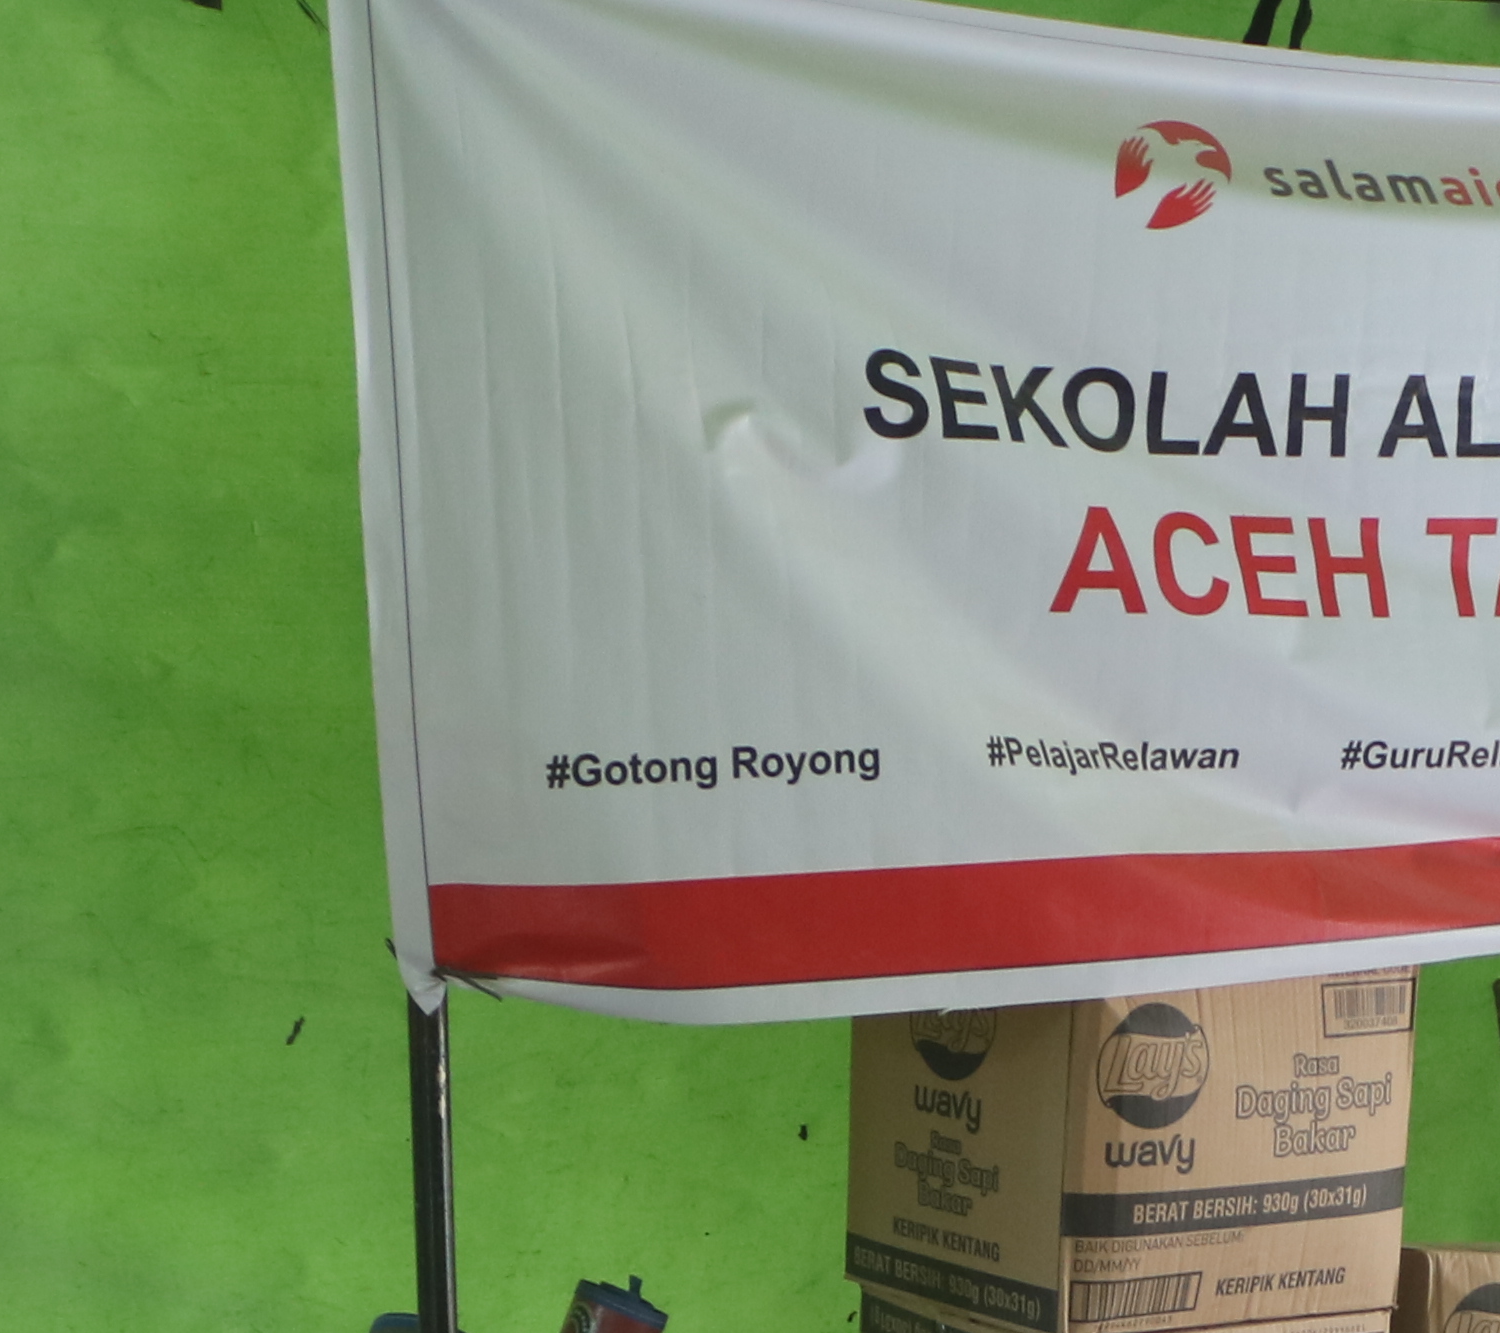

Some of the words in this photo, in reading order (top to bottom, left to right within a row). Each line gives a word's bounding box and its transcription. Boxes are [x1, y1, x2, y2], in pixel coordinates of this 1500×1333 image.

[862, 348, 1349, 458] SEKOLAH
[1048, 505, 1390, 618] ACEH
[545, 749, 718, 791] #Gotong
[730, 742, 882, 784] Royong
[986, 735, 1241, 775] #PelajarRelawan
[1104, 1031, 1203, 1101] Lay's
[1294, 1054, 1340, 1077] Rasa
[915, 1085, 981, 1134] wavy
[1236, 1084, 1331, 1124] Daging
[1336, 1073, 1393, 1115] Sapi
[1105, 1134, 1195, 1174] wavy
[1274, 1119, 1357, 1157] Bakar
[894, 1141, 957, 1187] Daging
[958, 1158, 999, 1196] Sapi
[918, 1182, 972, 1216] Bakar
[1133, 1201, 1189, 1225] BERAT
[1193, 1197, 1257, 1220] BERSIH:
[1262, 1191, 1299, 1215] 930g
[1303, 1184, 1367, 1212] (30x31g)
[893, 1216, 938, 1246] KERIPIK
[943, 1230, 1000, 1262] KENTANG
[1075, 1239, 1109, 1254] BAIK
[1112, 1235, 1183, 1253] DIGUNAKAN
[1187, 1230, 1245, 1247] SEBELUM:
[854, 1246, 891, 1274] BERAT
[984, 1284, 1041, 1321] (30x31g)
[1073, 1258, 1142, 1273] DD/MM/YY
[1215, 1273, 1274, 1297] KERIPIK
[1279, 1267, 1346, 1290] KENTANG
